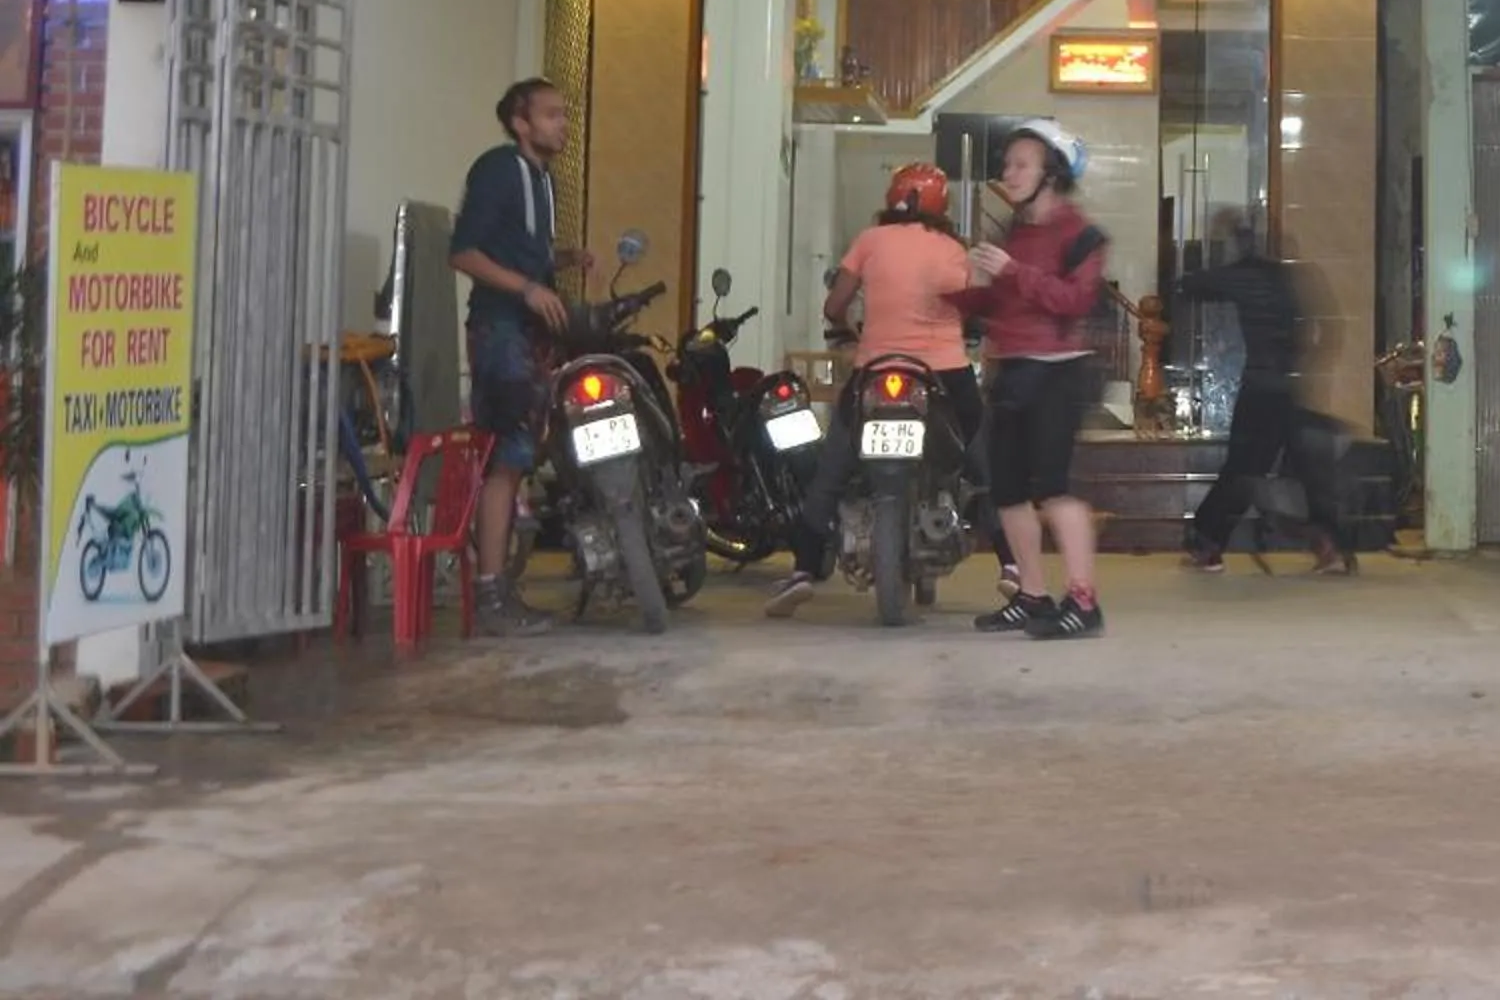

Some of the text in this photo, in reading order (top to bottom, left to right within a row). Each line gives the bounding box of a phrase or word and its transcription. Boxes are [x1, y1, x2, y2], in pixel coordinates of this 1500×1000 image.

[83, 193, 175, 234] BICYCLE
[73, 240, 99, 264] And
[68, 272, 183, 314] MOTORBIKE
[80, 326, 172, 369] FOR RENT
